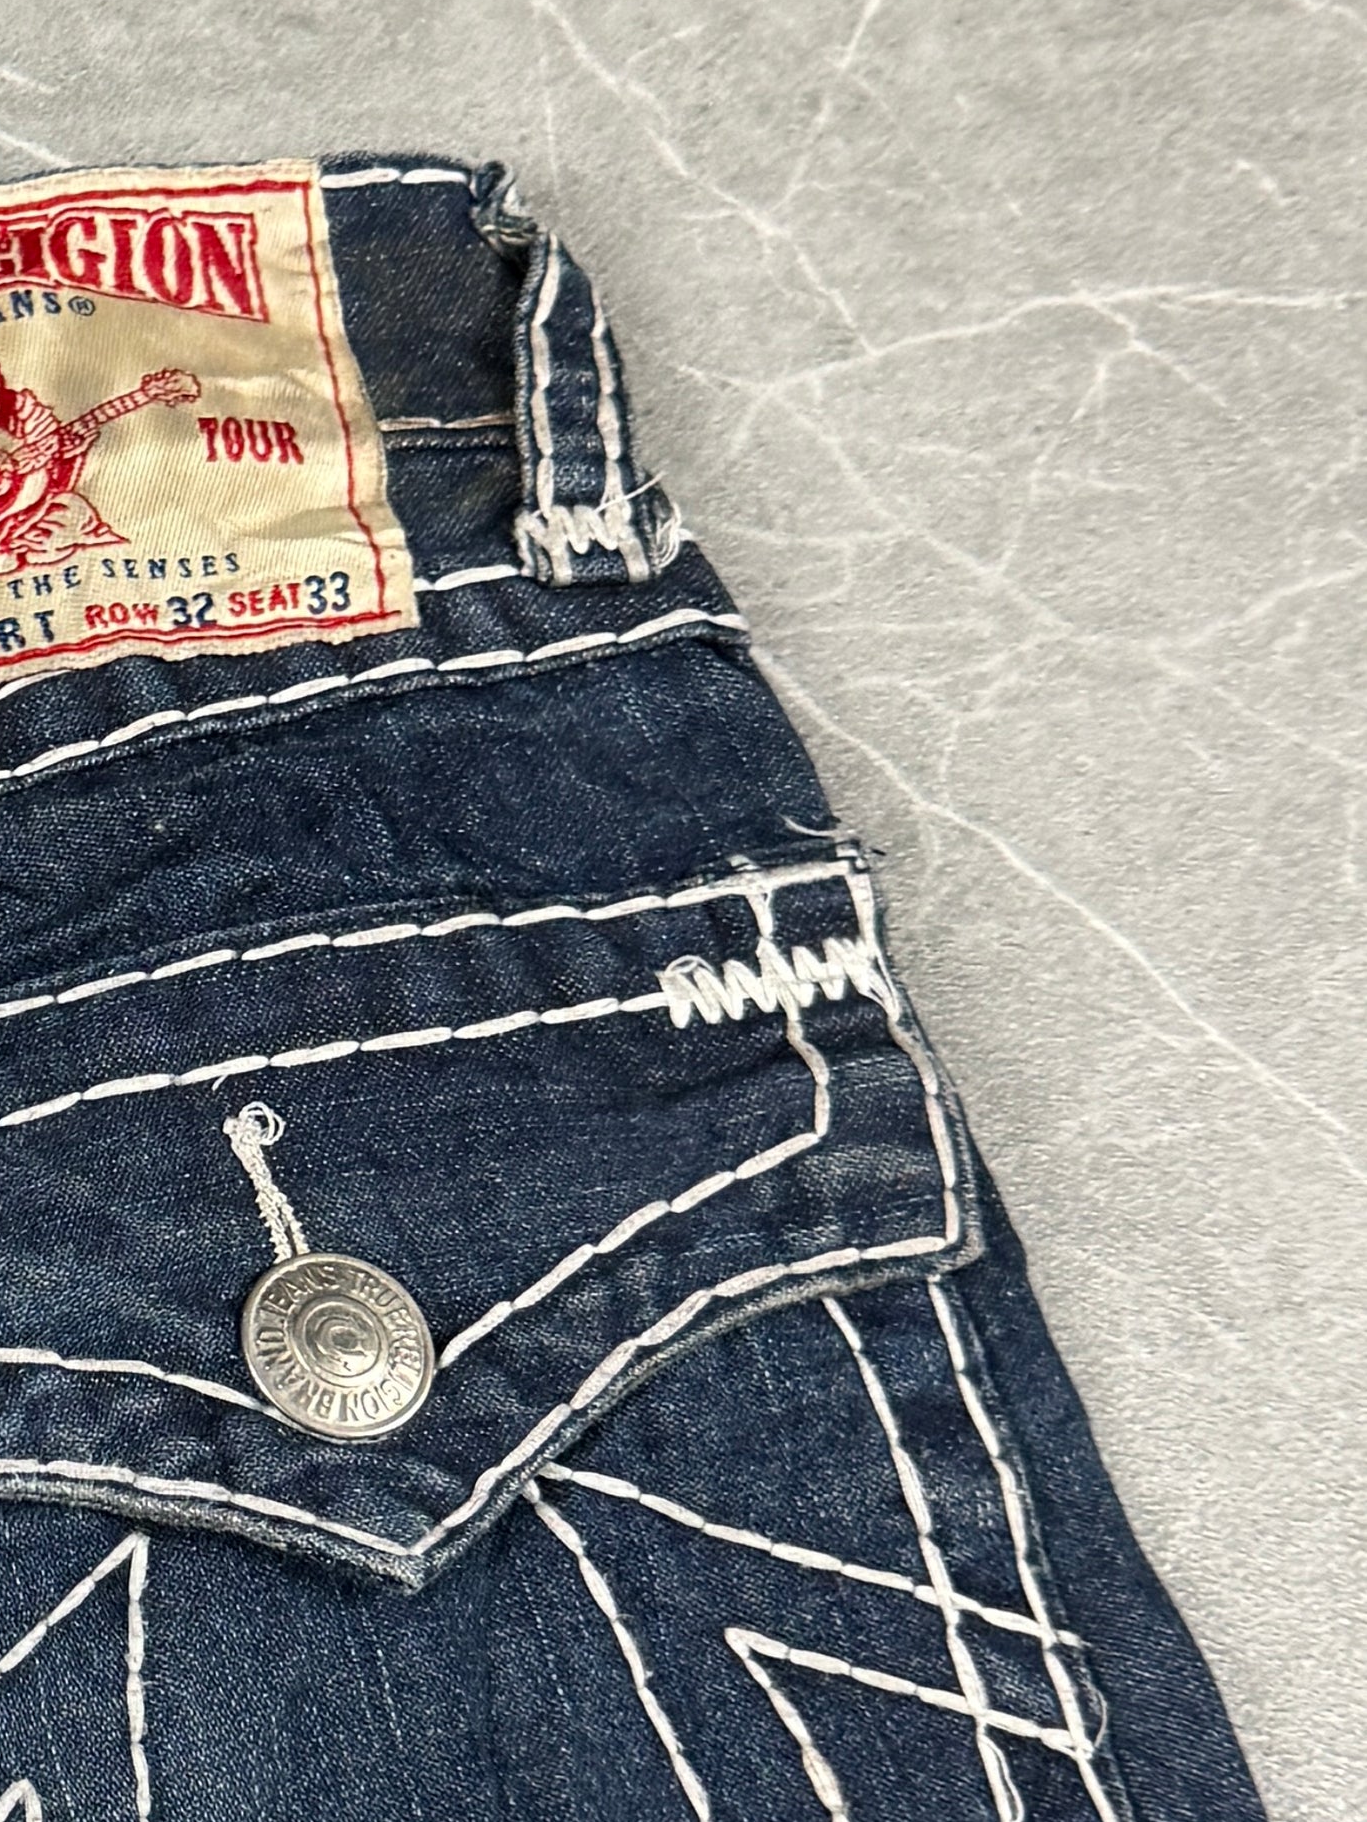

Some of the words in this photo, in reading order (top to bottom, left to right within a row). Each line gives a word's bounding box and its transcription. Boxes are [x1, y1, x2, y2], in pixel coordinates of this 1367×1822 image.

[197, 417, 304, 465] TOUR
[7, 566, 80, 599] THE
[101, 553, 240, 579] SENSES
[34, 609, 55, 642] T
[84, 603, 159, 630] ROW
[167, 592, 218, 629] 32
[227, 583, 300, 618] SEAT
[304, 571, 352, 615] 33
